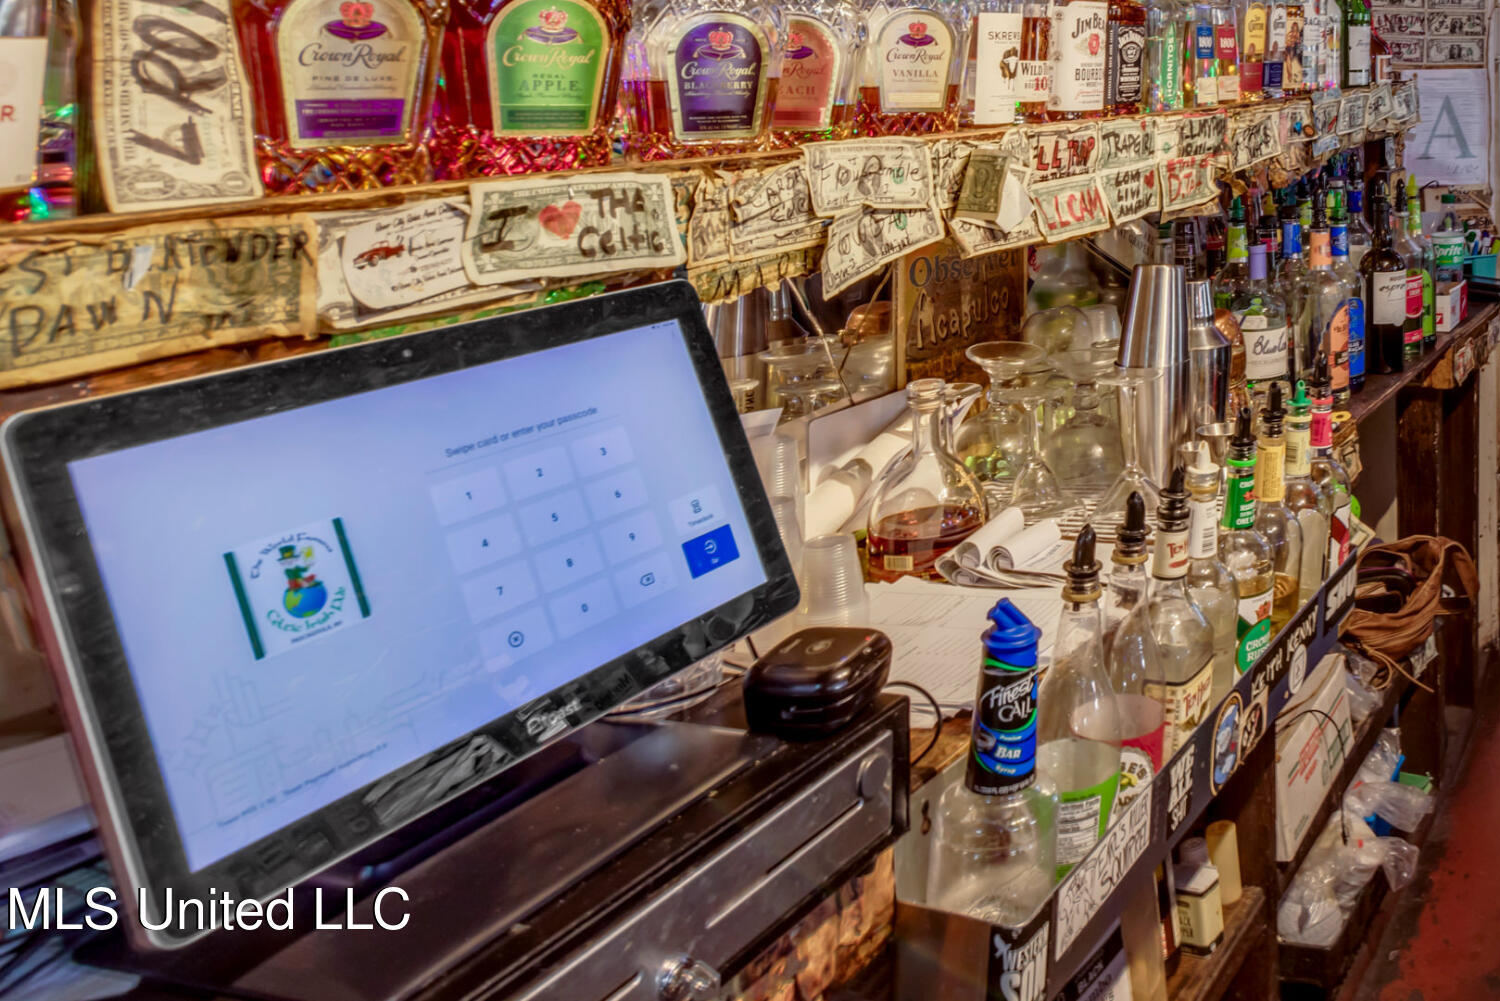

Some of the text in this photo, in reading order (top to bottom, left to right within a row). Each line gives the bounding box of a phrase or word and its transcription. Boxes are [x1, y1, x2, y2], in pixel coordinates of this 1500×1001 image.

[1071, 16, 1091, 39] JIM
[298, 41, 405, 70] Crown Royal
[502, 45, 596, 70] Crown Royal
[886, 46, 945, 65] Crown Royal
[344, 75, 360, 83] DE
[717, 60, 756, 82] Royal
[892, 68, 939, 78] VANILLA
[1021, 61, 1043, 76] WILD
[1166, 35, 1175, 102] HORNITOS
[518, 80, 580, 92] APPLE
[1415, 94, 1478, 160] A
[480, 205, 529, 254] I
[576, 225, 665, 259] Celtic
[1432, 243, 1464, 260] Sprite
[915, 286, 1011, 349] Acapulco
[444, 440, 475, 459] Swipe
[476, 433, 499, 448] card
[511, 424, 535, 440] enter
[536, 418, 556, 433] your
[556, 406, 599, 427] passcode
[987, 672, 1036, 709] Finest
[994, 745, 1022, 760] BAR
